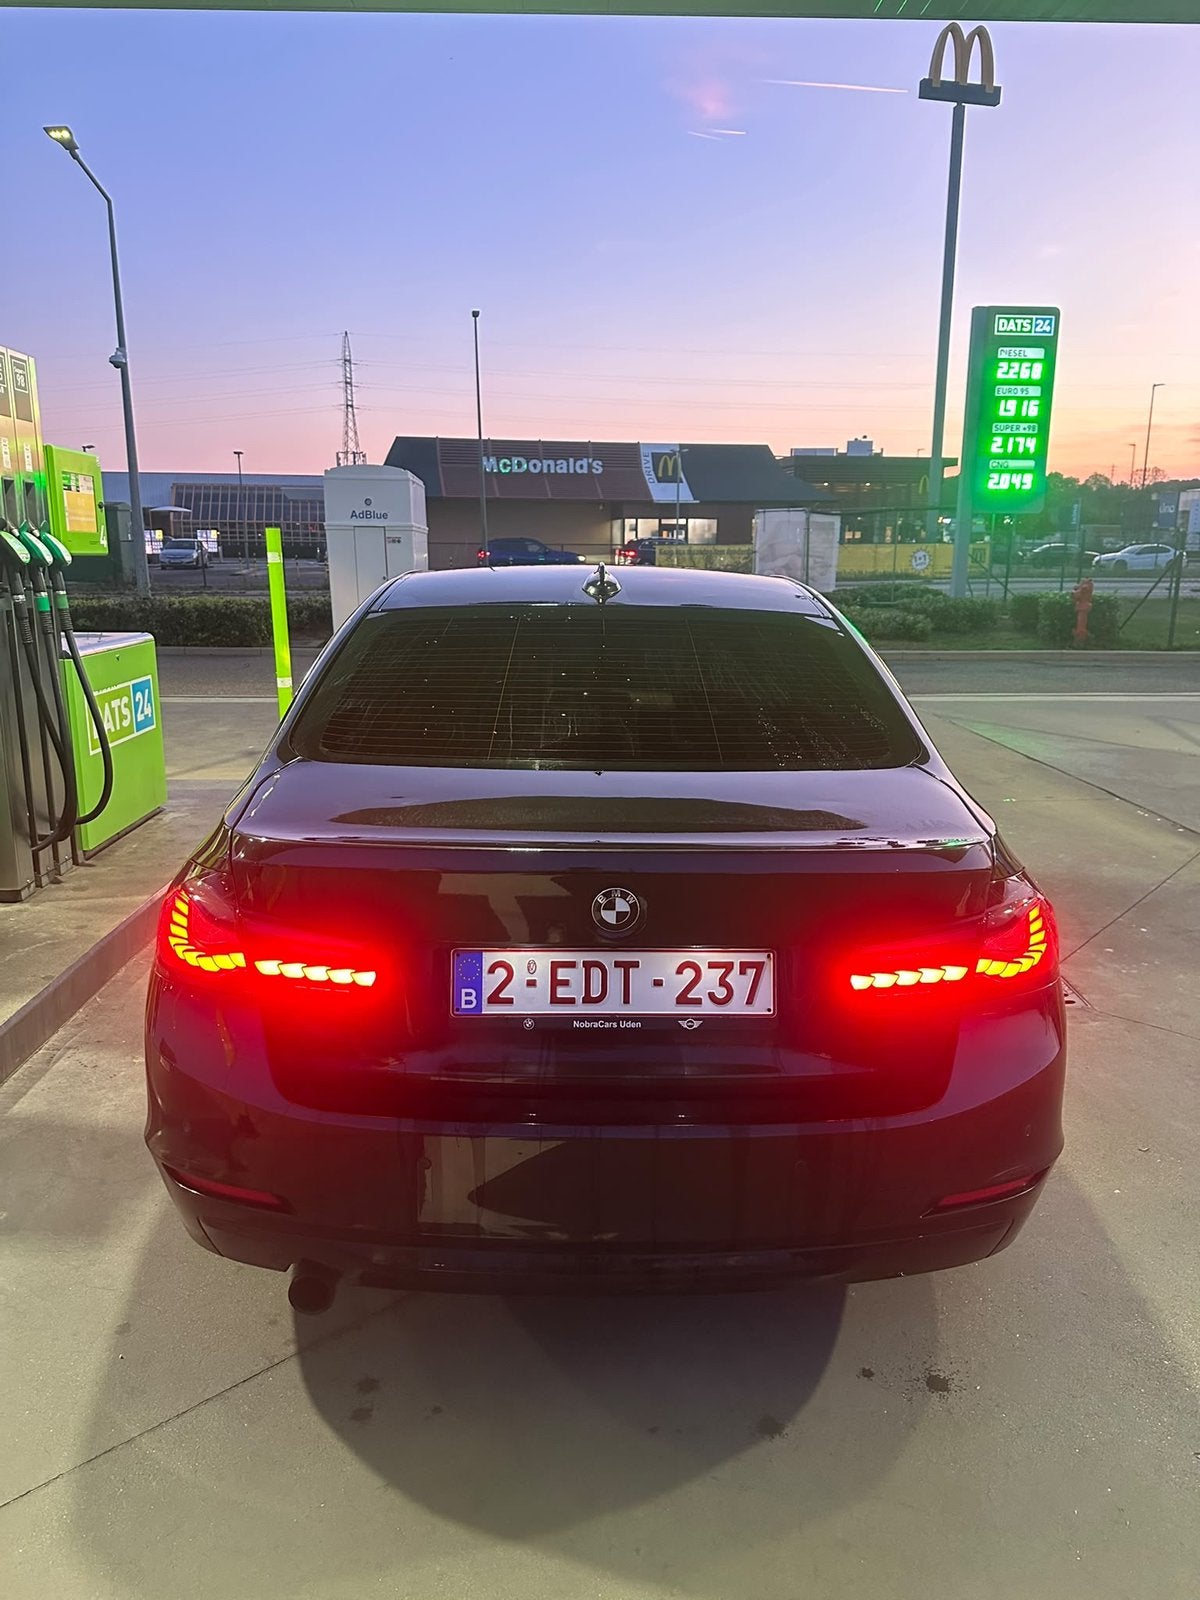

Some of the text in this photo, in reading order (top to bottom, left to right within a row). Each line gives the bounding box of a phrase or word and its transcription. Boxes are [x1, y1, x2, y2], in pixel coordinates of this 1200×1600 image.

[998, 318, 1051, 333] DATS 24
[996, 387, 1030, 395] EURO 95
[994, 424, 1021, 432] SUPER
[481, 456, 604, 475] McDonald's
[643, 451, 656, 484] DRIVE
[990, 461, 1009, 469] CNG
[350, 510, 389, 519] AdBlue
[135, 688, 152, 722] 24
[597, 889, 637, 905] BMW
[461, 988, 478, 1009] B
[573, 1020, 642, 1029] NobraCars Uden
